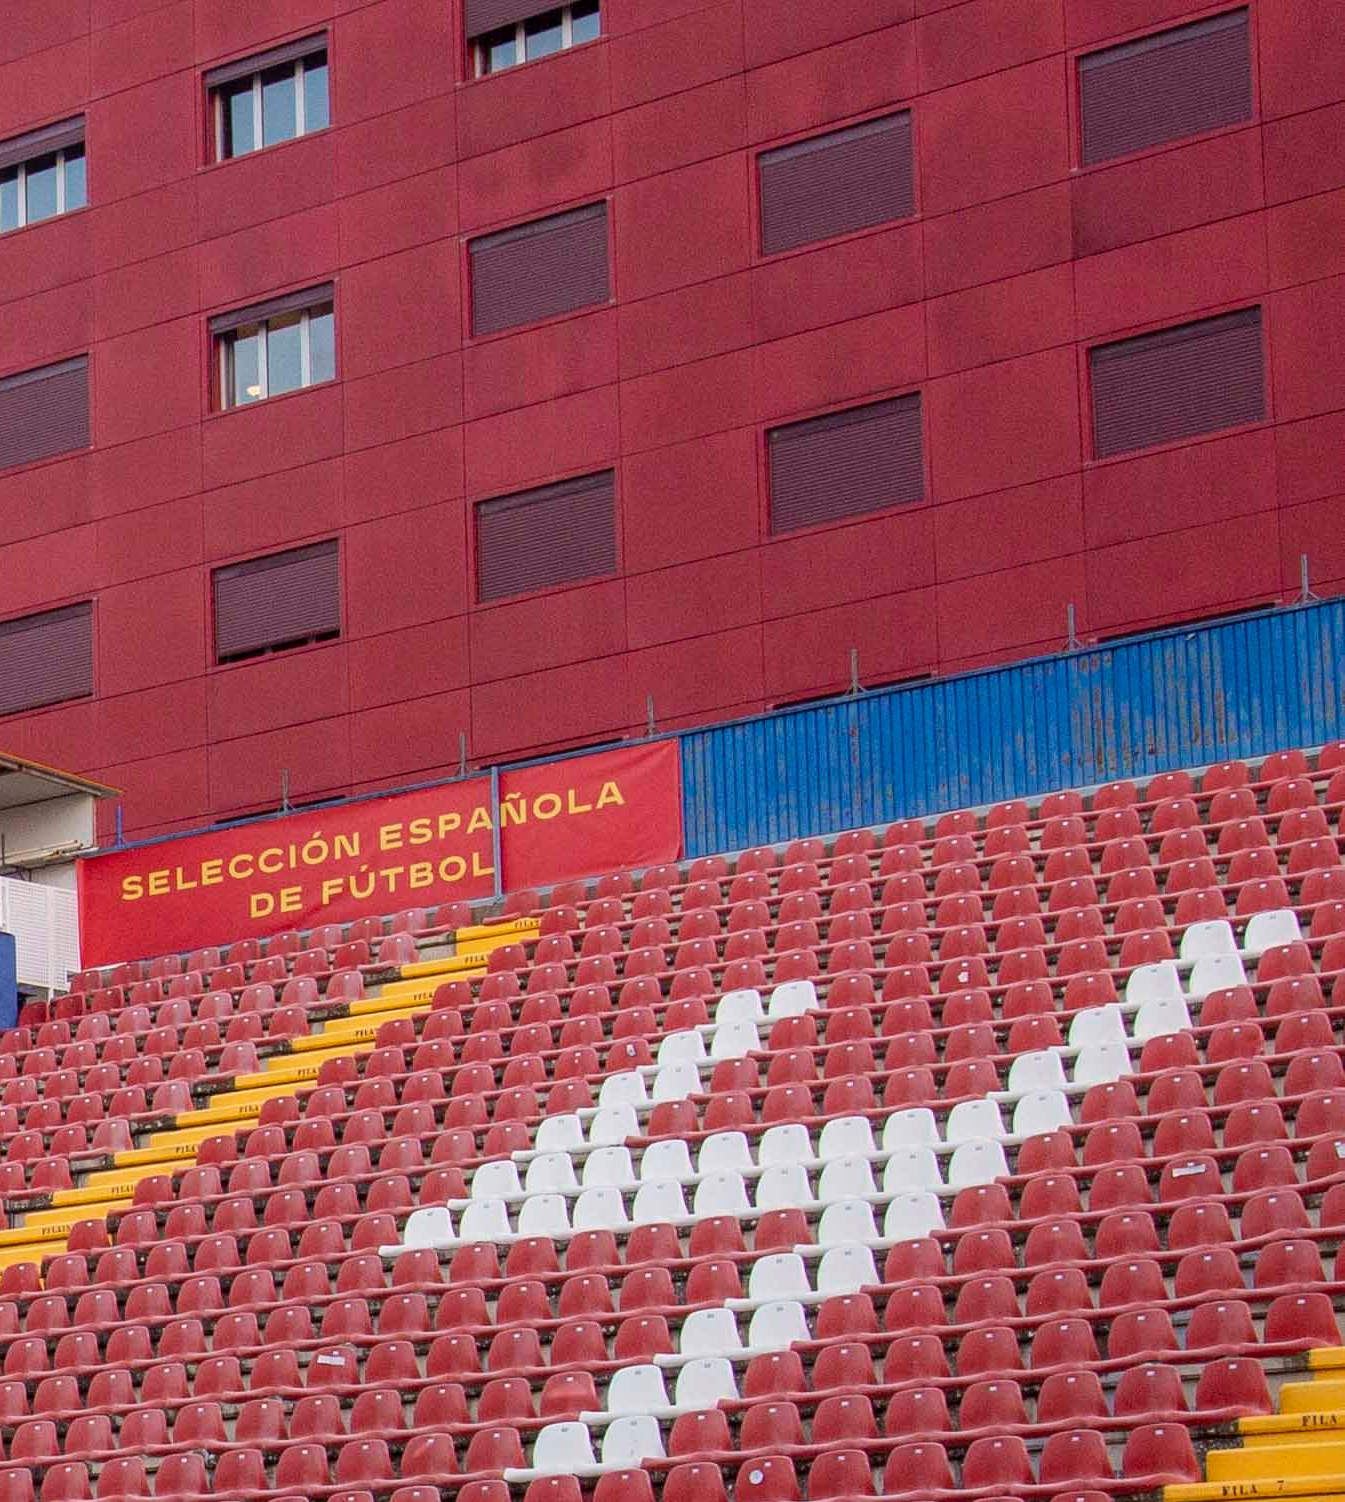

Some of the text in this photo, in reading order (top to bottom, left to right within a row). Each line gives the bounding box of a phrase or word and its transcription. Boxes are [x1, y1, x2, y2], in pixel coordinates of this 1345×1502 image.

[122, 782, 626, 901] SELECCIÓN ESPAÑOLA
[250, 853, 496, 919] DE FÚTBOL
[1301, 1413, 1338, 1427] FILA
[1221, 1485, 1259, 1497] FILA
